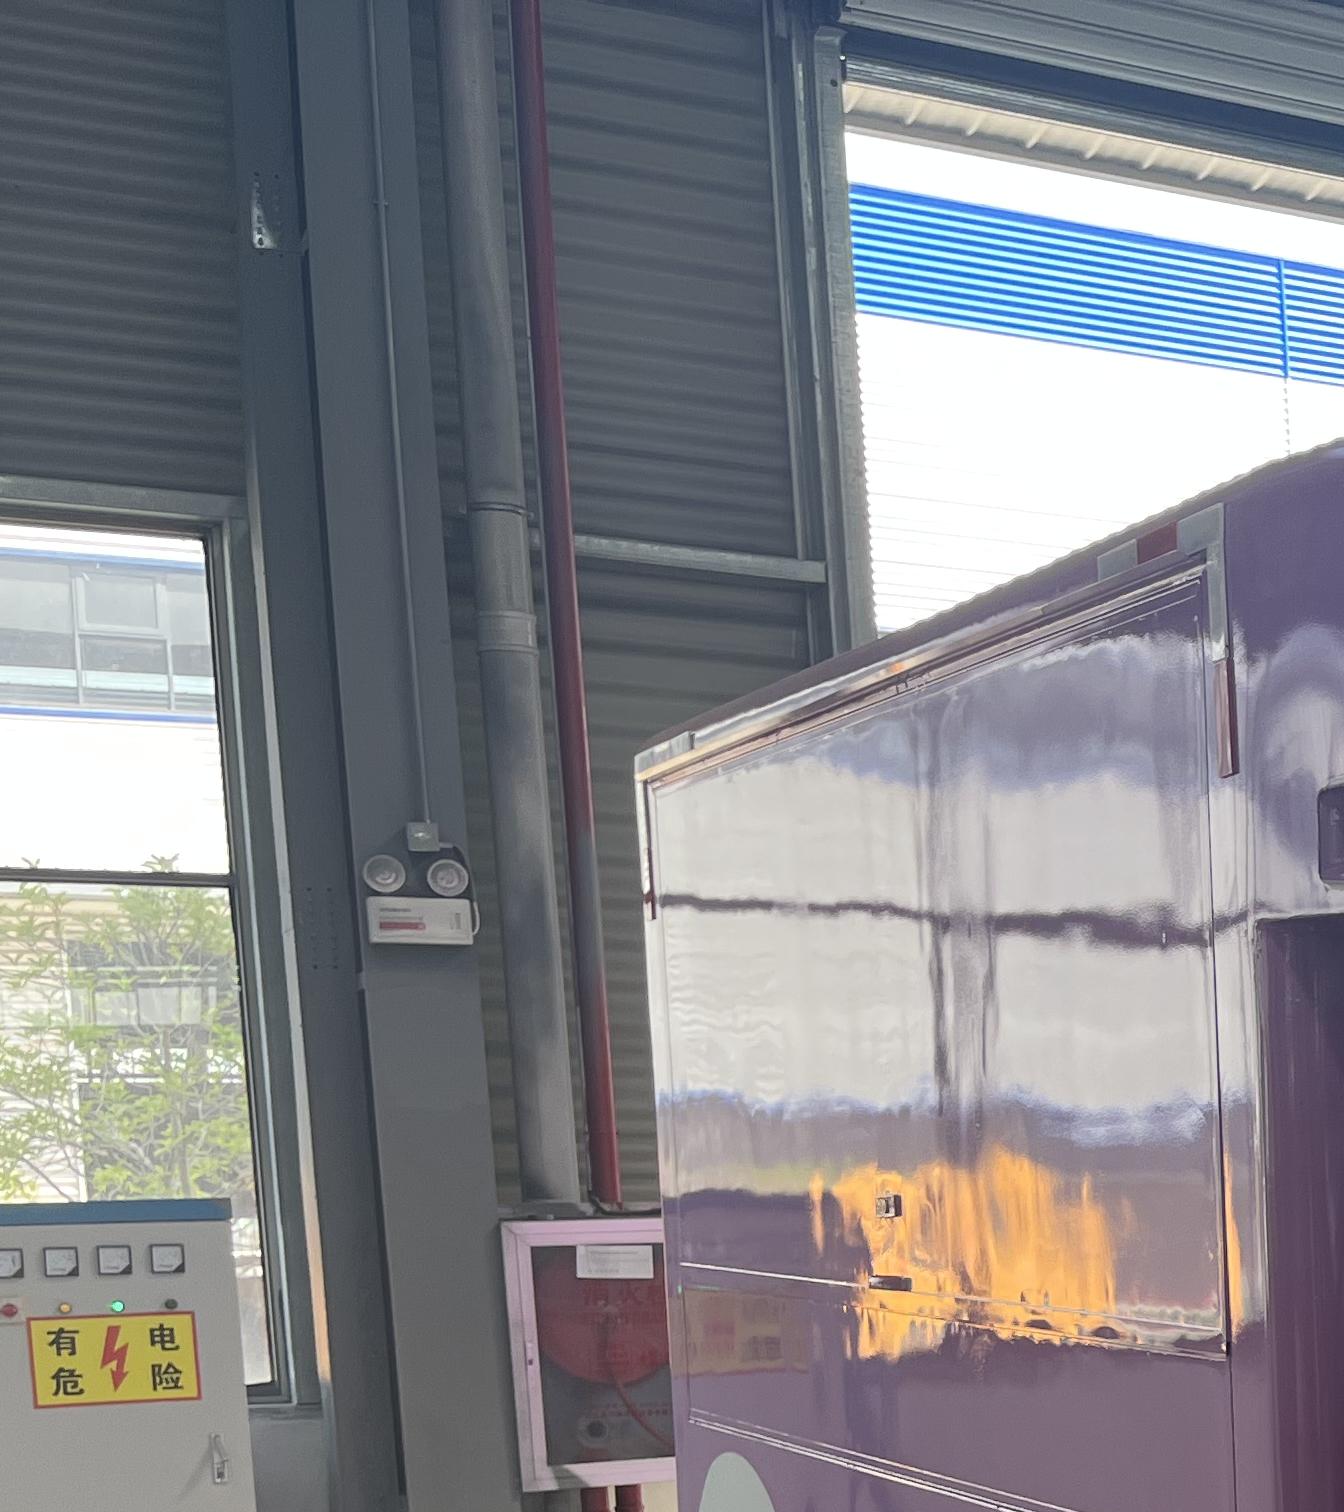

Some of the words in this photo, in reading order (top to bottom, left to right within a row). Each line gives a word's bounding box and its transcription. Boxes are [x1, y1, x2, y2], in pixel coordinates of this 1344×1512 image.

[47, 1328, 79, 1356] 有
[150, 1324, 180, 1351] 电
[52, 1367, 84, 1396] 危
[152, 1363, 183, 1391] 险
